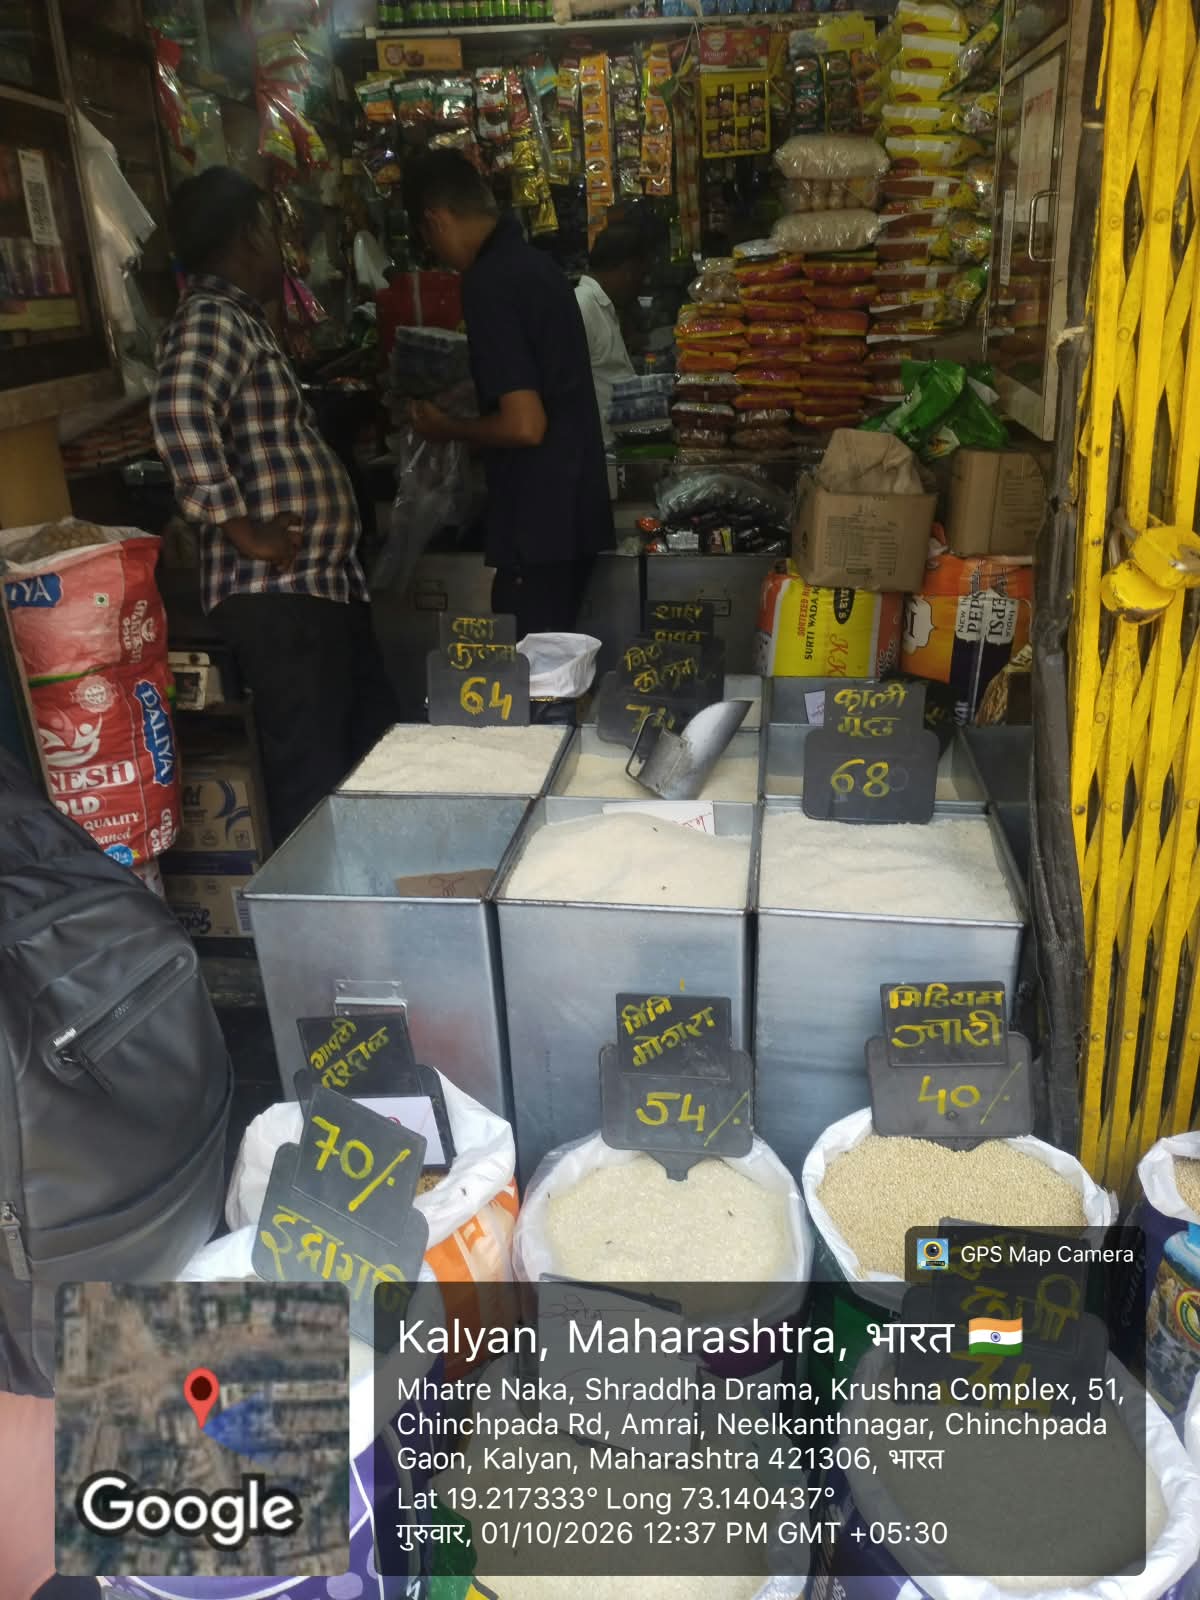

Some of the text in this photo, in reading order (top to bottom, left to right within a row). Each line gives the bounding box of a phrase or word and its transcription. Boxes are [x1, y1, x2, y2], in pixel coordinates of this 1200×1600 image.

[10, 576, 52, 602] IYA
[809, 597, 819, 628] WADA
[967, 592, 984, 633] PEPS
[988, 594, 1007, 637] EPSI
[804, 631, 815, 661] SURTI
[459, 677, 513, 721] 64
[141, 686, 176, 778] DALIYA
[48, 762, 132, 792] NESH
[831, 758, 891, 797] 68
[56, 796, 100, 816] OLD
[83, 812, 140, 831] QUALITY
